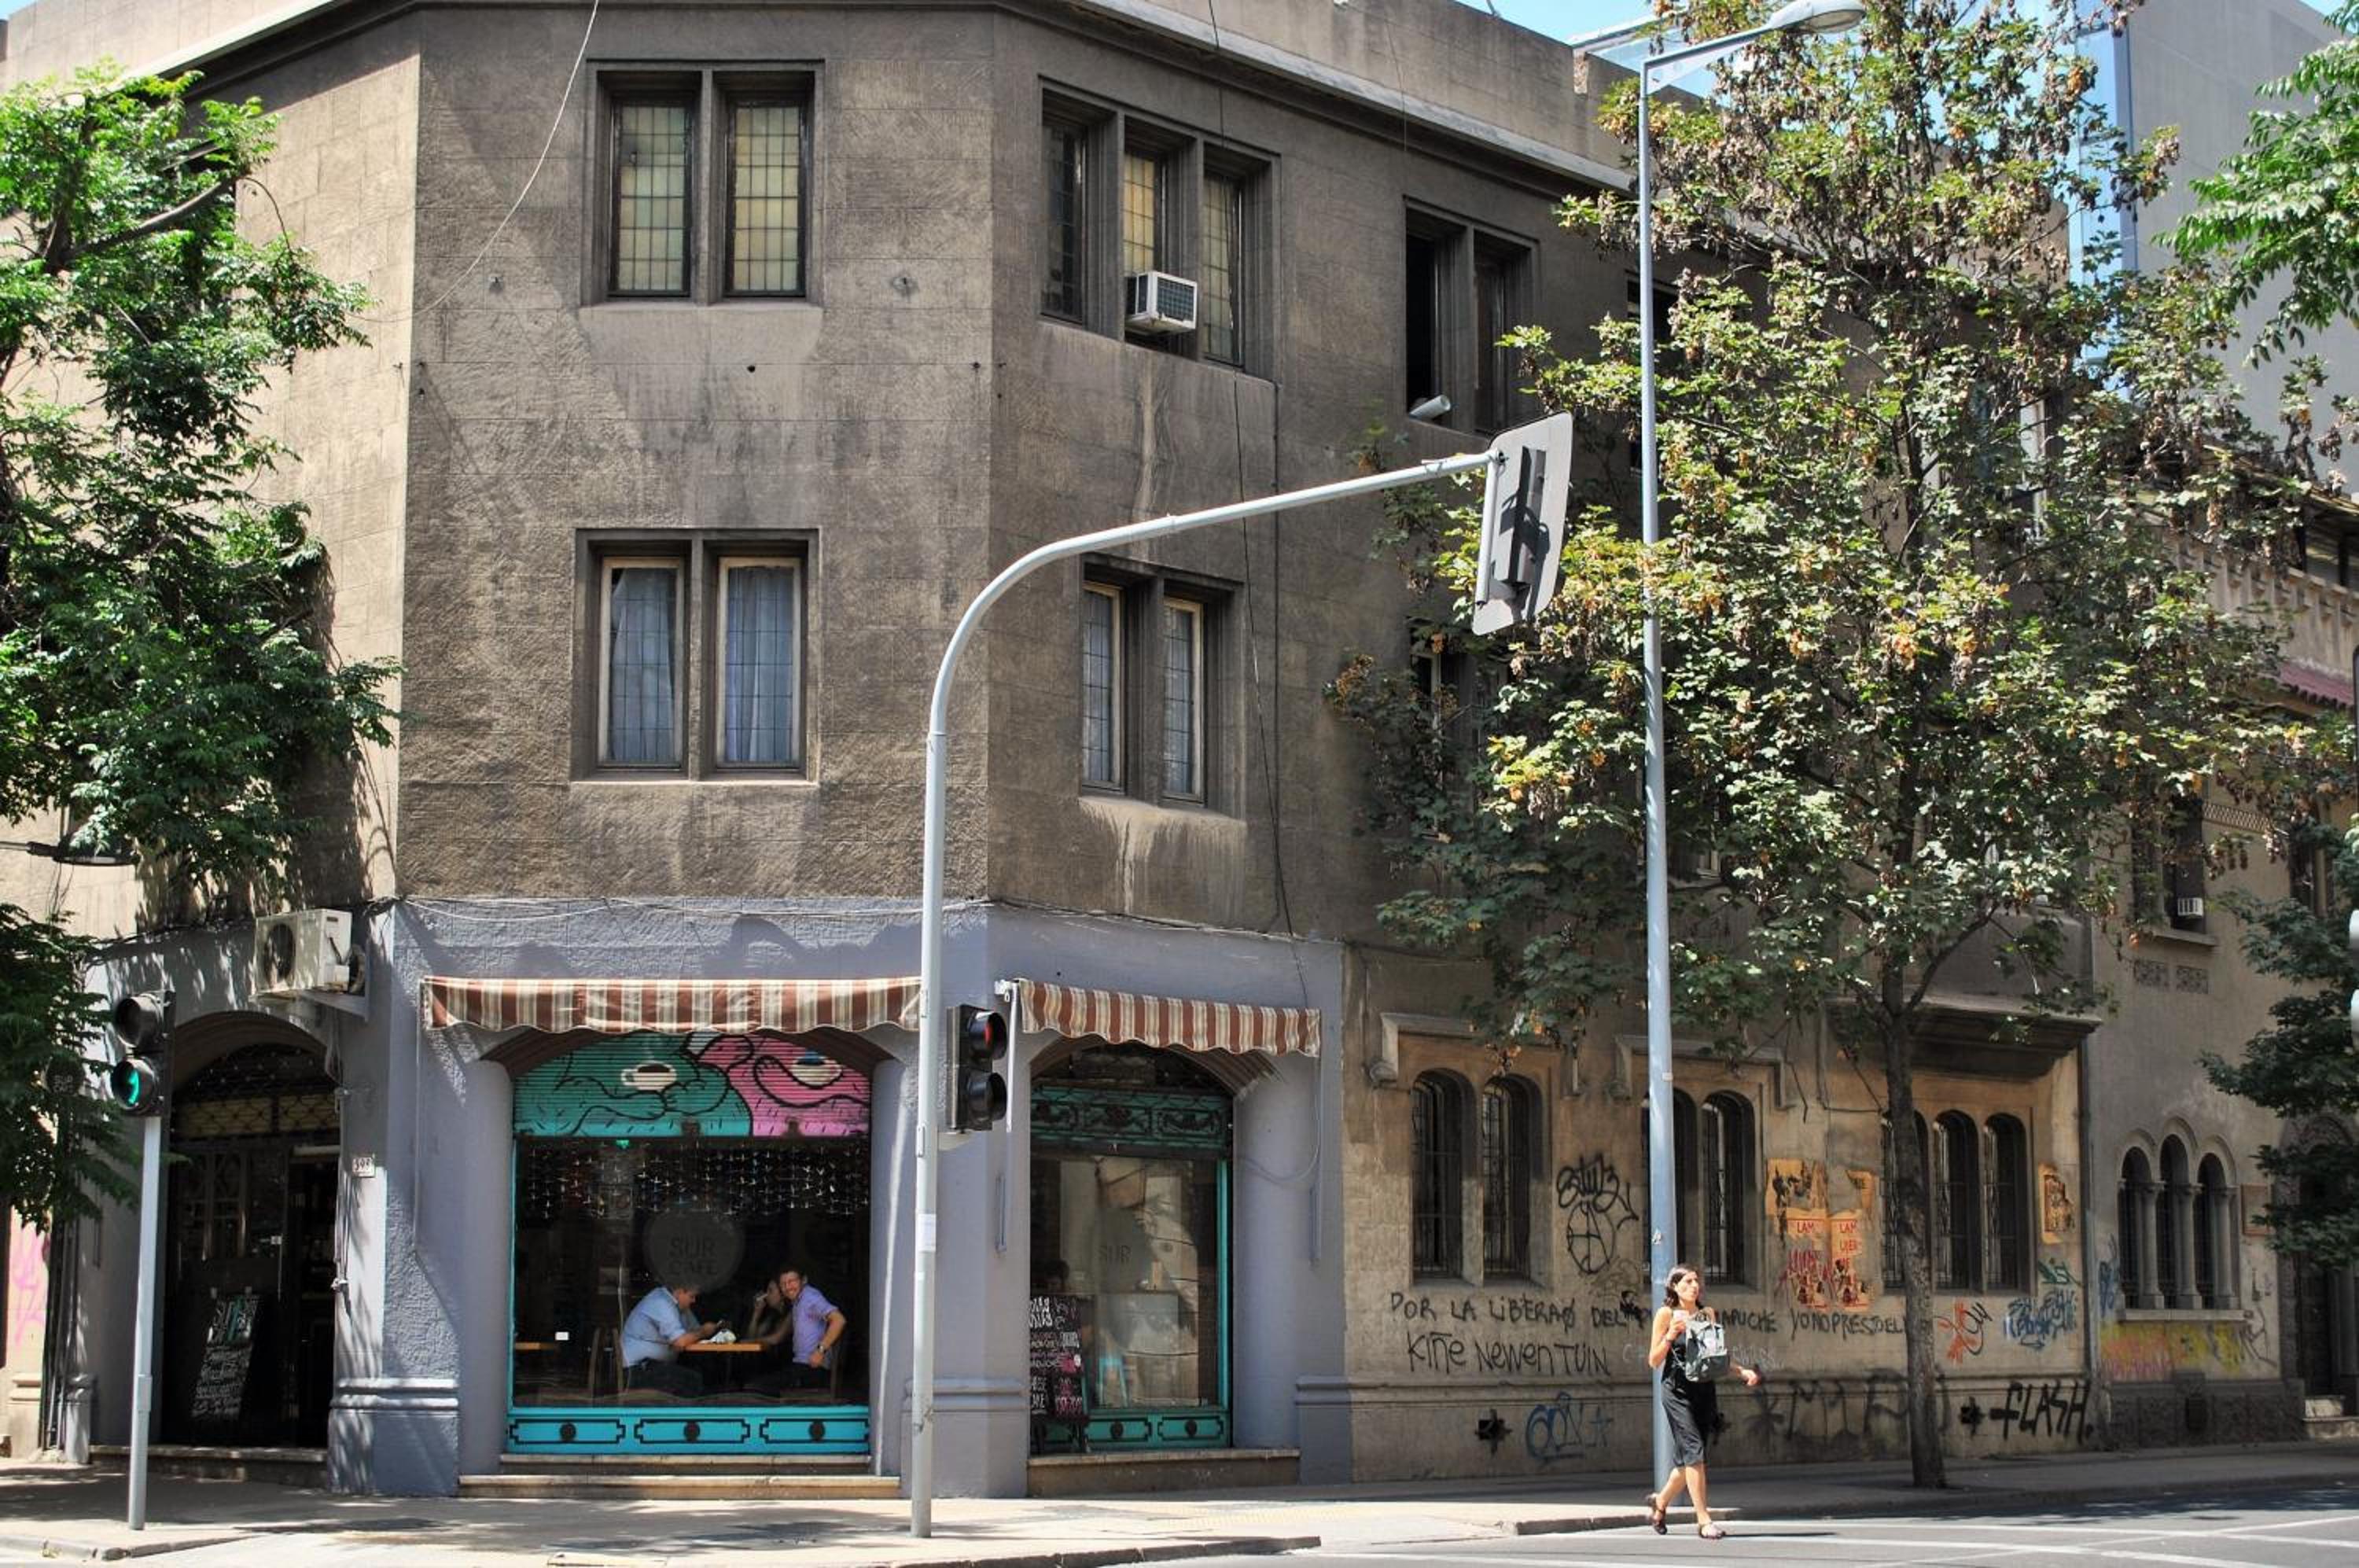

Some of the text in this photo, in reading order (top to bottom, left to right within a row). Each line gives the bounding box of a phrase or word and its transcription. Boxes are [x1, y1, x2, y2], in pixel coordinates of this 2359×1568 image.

[669, 1233, 716, 1259] SUR
[1391, 1292, 1437, 1321] POR
[1451, 1299, 1477, 1322] LA
[1714, 1309, 1778, 1334] APUCHE
